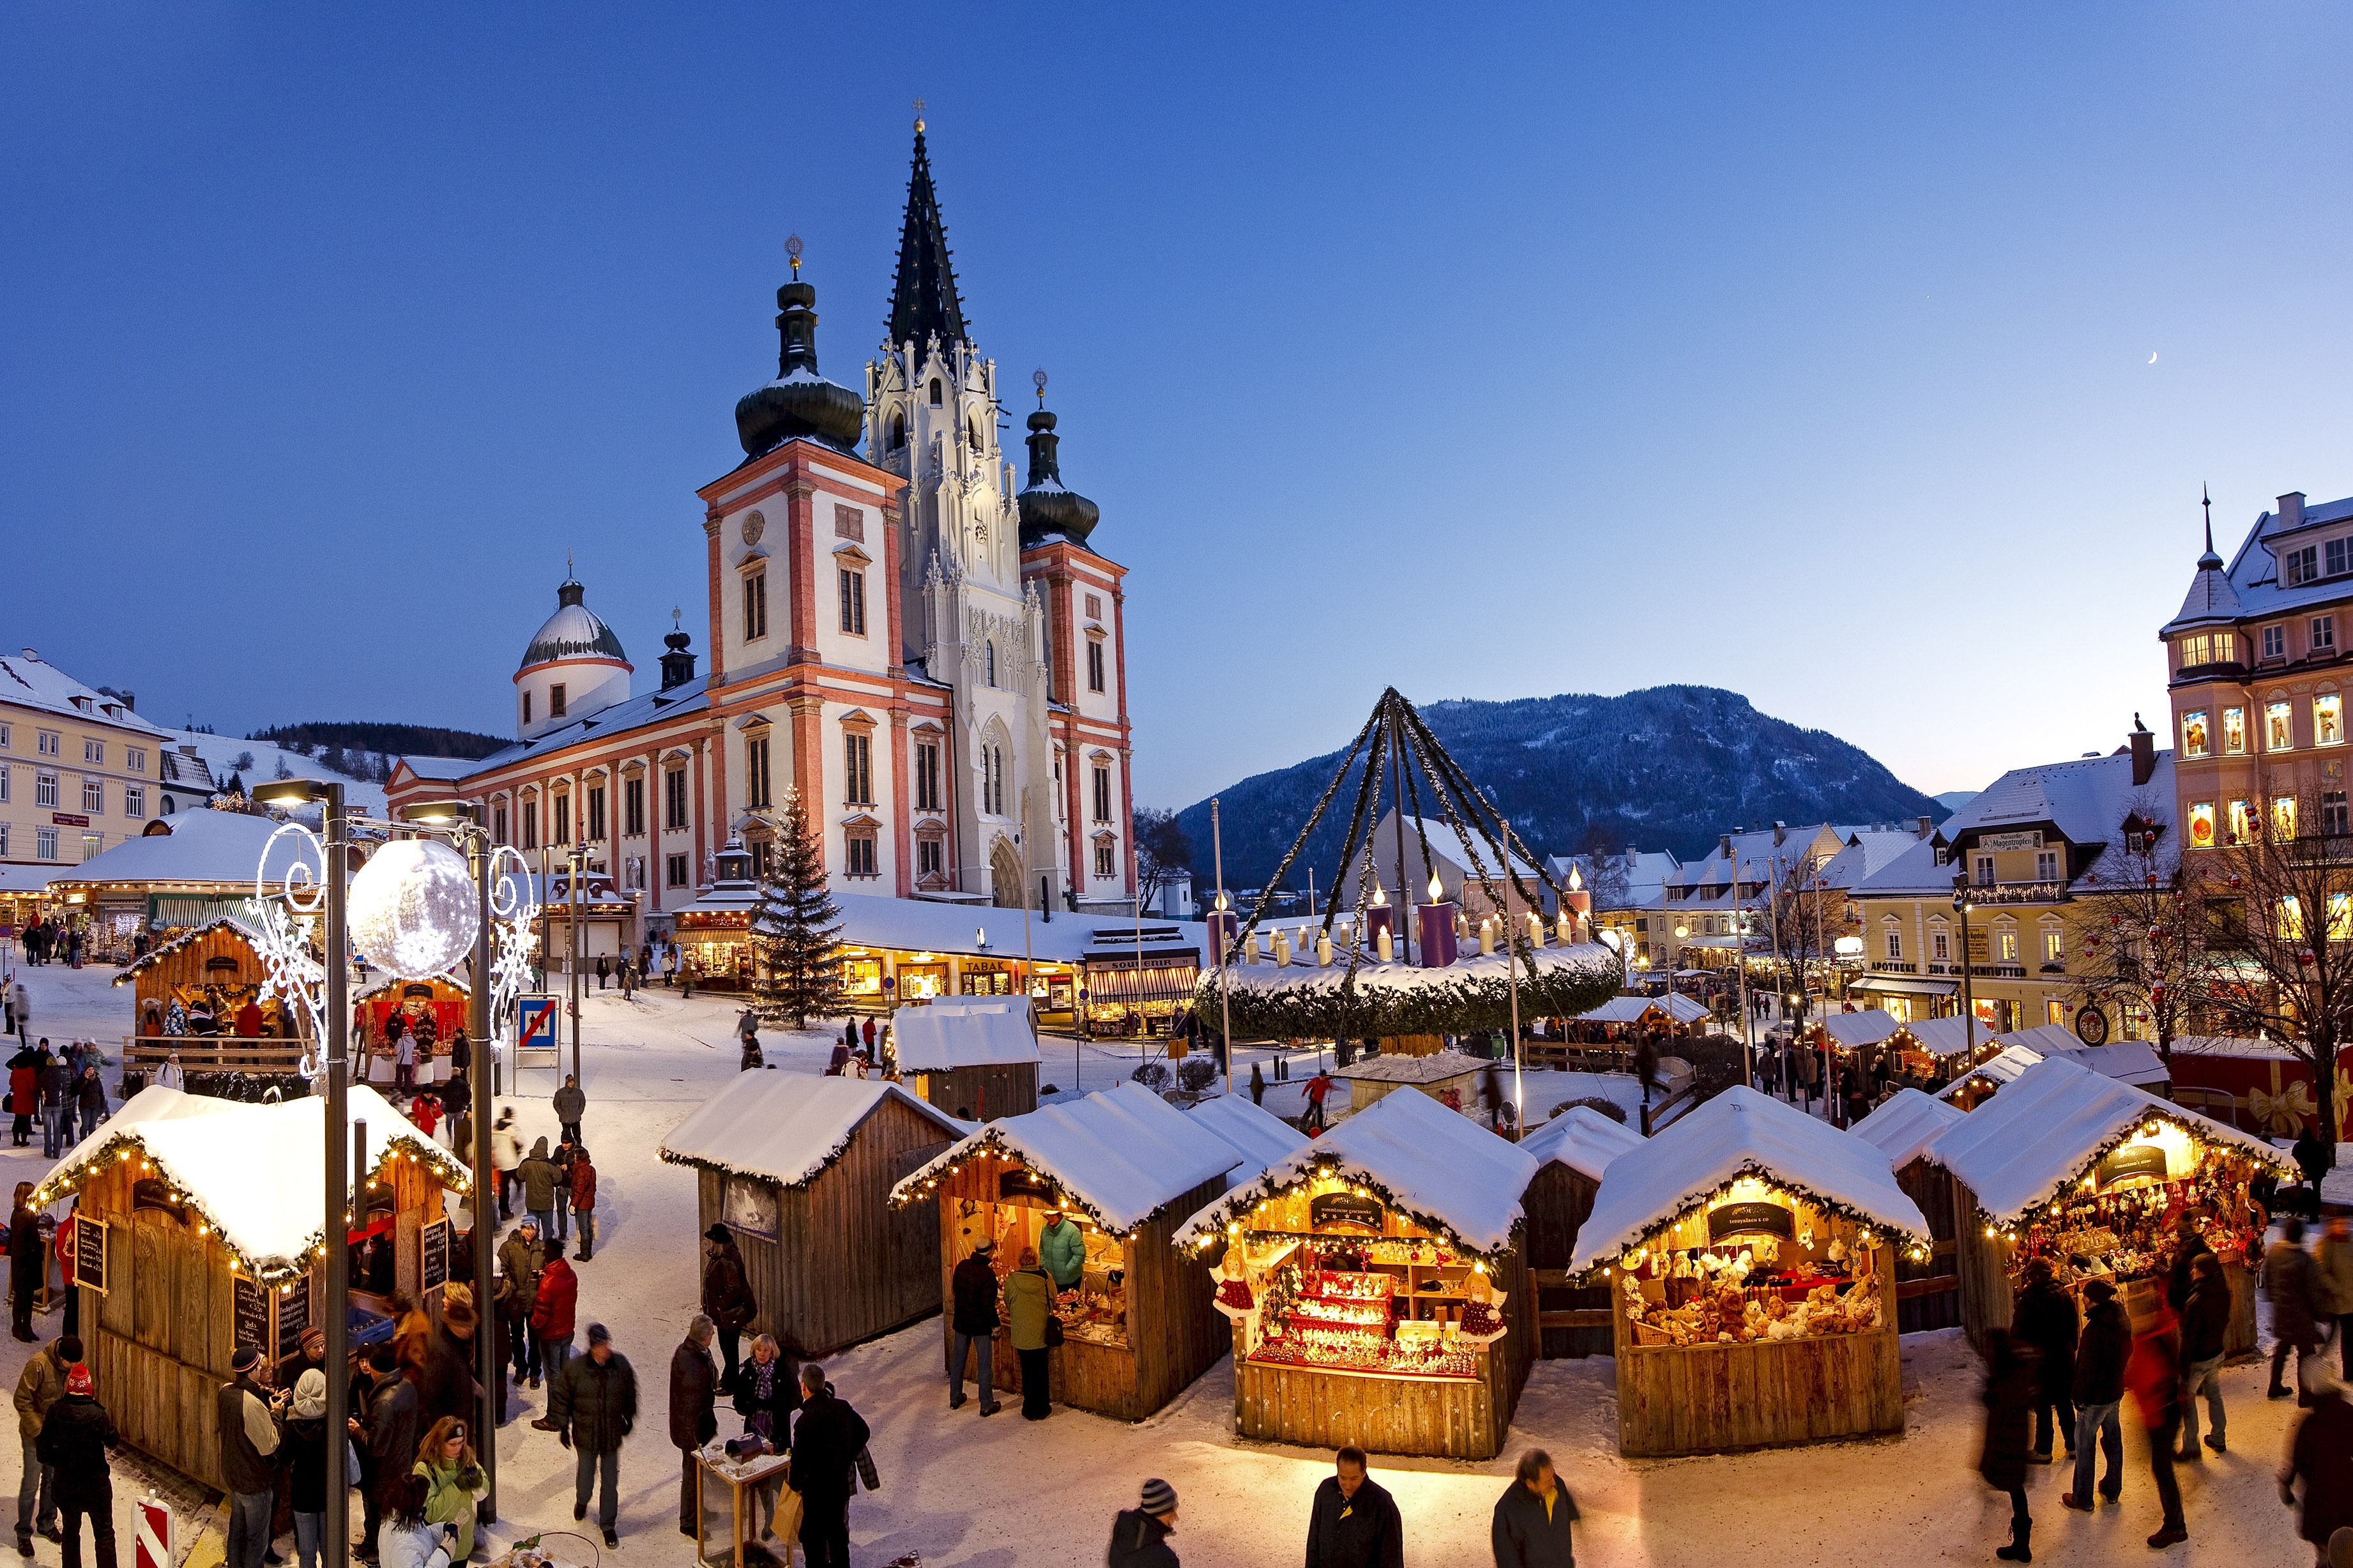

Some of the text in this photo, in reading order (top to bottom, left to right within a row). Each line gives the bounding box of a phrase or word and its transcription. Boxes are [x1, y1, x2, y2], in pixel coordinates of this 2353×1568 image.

[1993, 837, 2032, 848] Magentropfen
[966, 961, 1004, 971] TABAK
[1112, 959, 1172, 969] SOUVENIR
[1871, 961, 1916, 973] APOTHEKE
[1928, 964, 1945, 975] ZUR
